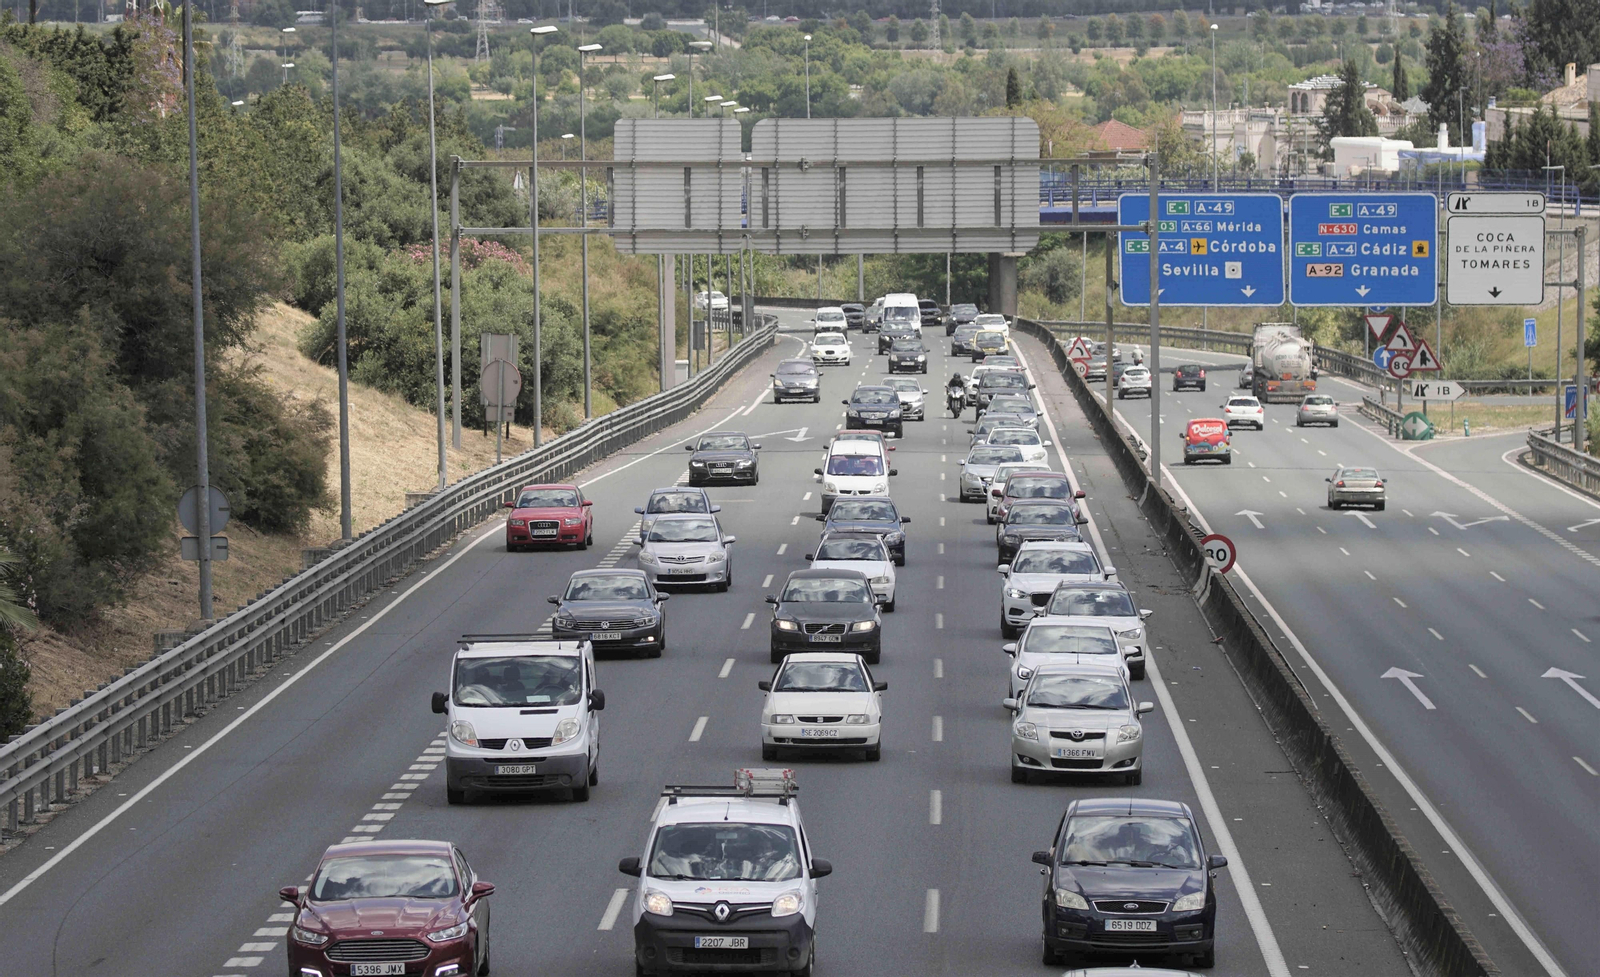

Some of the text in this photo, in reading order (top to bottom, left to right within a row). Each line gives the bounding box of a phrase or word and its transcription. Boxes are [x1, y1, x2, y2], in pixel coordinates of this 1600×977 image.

[1168, 203, 1232, 212] E-1 A-49
[1332, 206, 1396, 215] E-1 A-49
[1217, 221, 1262, 231] Mérida
[1320, 225, 1406, 234] N-630 Camas
[1477, 233, 1515, 242] COCA
[1127, 239, 1276, 252] E-5 A-4 Córdoba
[1298, 243, 1407, 255] E-5 A-4 Cádiz
[1494, 244, 1536, 253] PIÑERA
[1461, 260, 1531, 269] TOMARES
[1162, 264, 1219, 276] Sevilla
[1309, 264, 1419, 276] A-92 Granada
[1394, 362, 1408, 370] 80
[1437, 386, 1450, 395] 1B
[1112, 921, 1132, 930] 6519
[702, 938, 746, 947] 2207 JBR
[357, 964, 402, 974] 5396 JMX
